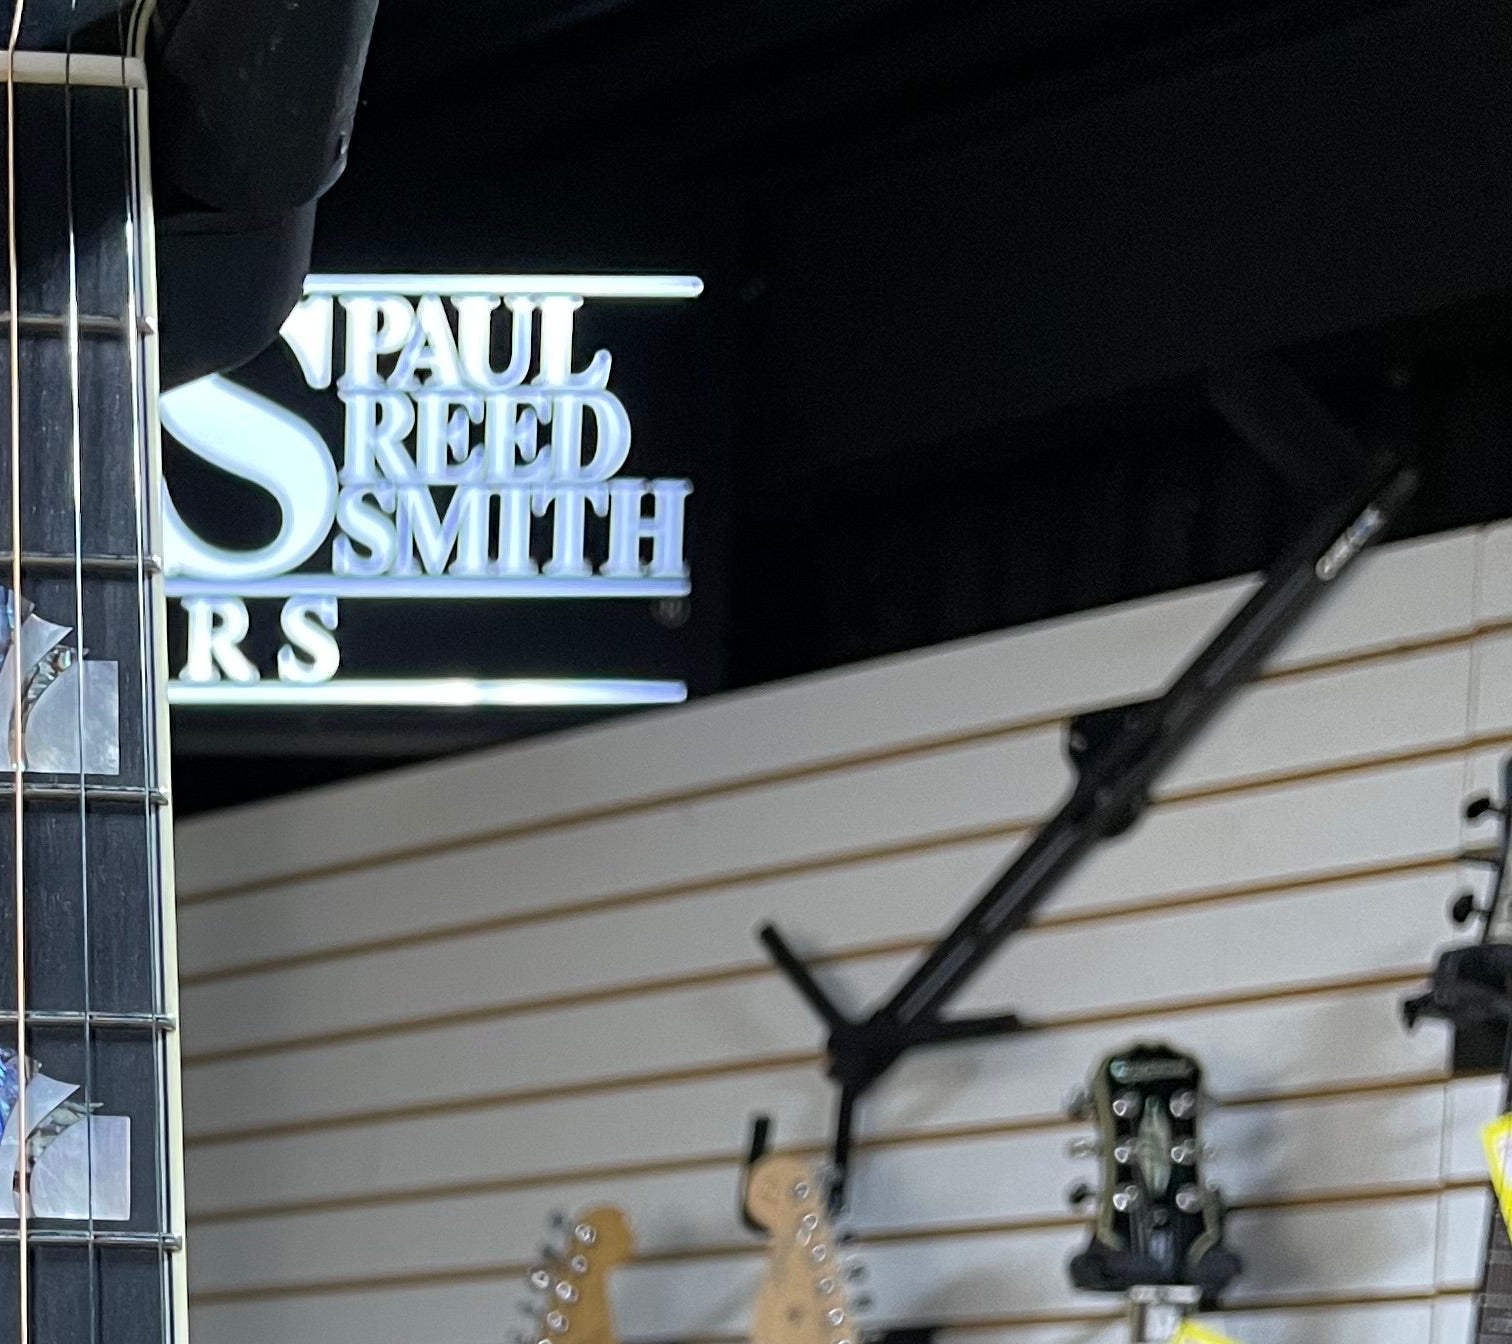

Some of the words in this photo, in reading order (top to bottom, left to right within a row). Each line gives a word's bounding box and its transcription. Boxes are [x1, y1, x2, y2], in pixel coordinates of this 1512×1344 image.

[338, 294, 612, 391] PAUL
[338, 389, 631, 485] REED
[333, 478, 693, 577] SMITH
